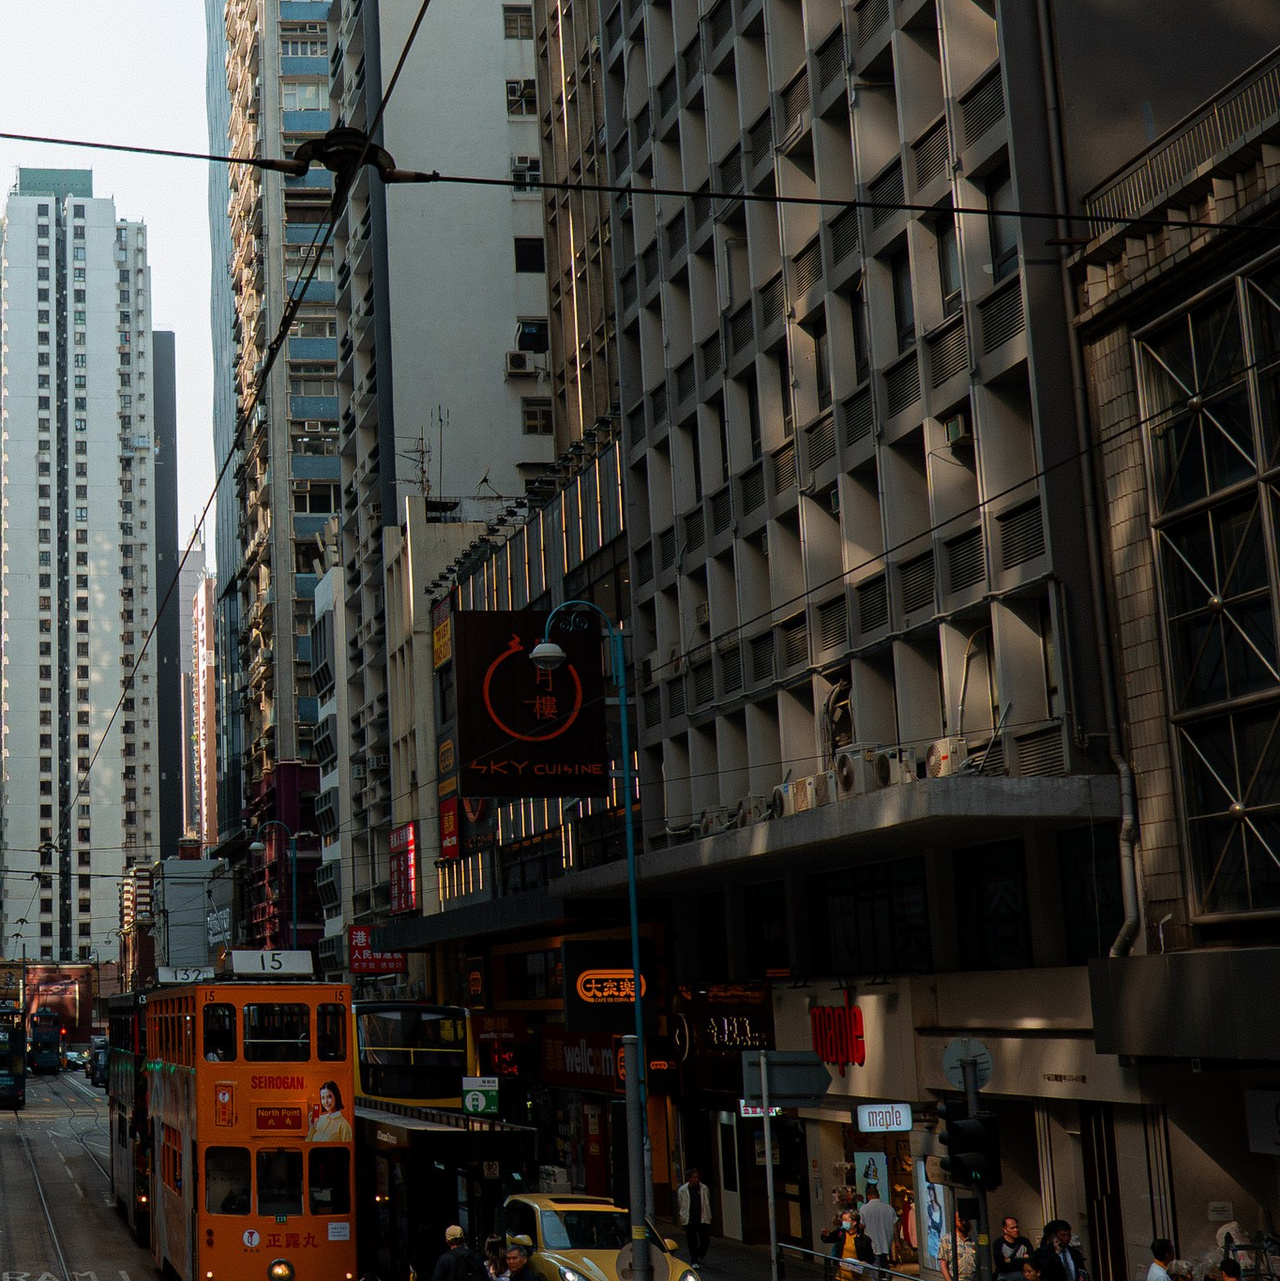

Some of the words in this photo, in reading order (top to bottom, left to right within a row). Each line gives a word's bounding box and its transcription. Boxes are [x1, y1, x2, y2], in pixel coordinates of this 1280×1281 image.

[534, 763, 604, 776] CUISINE
[261, 952, 283, 972] 15
[174, 968, 203, 982] 132
[204, 991, 216, 1003] 15
[334, 990, 345, 1002] 15
[810, 989, 866, 1078] maple
[564, 1038, 615, 1077] wellcom
[251, 1075, 304, 1090] SEIROGAN
[258, 1109, 279, 1118] North
[281, 1109, 300, 1117] Point
[868, 1106, 902, 1129] maple
[265, 1232, 319, 1249] 正露丸
